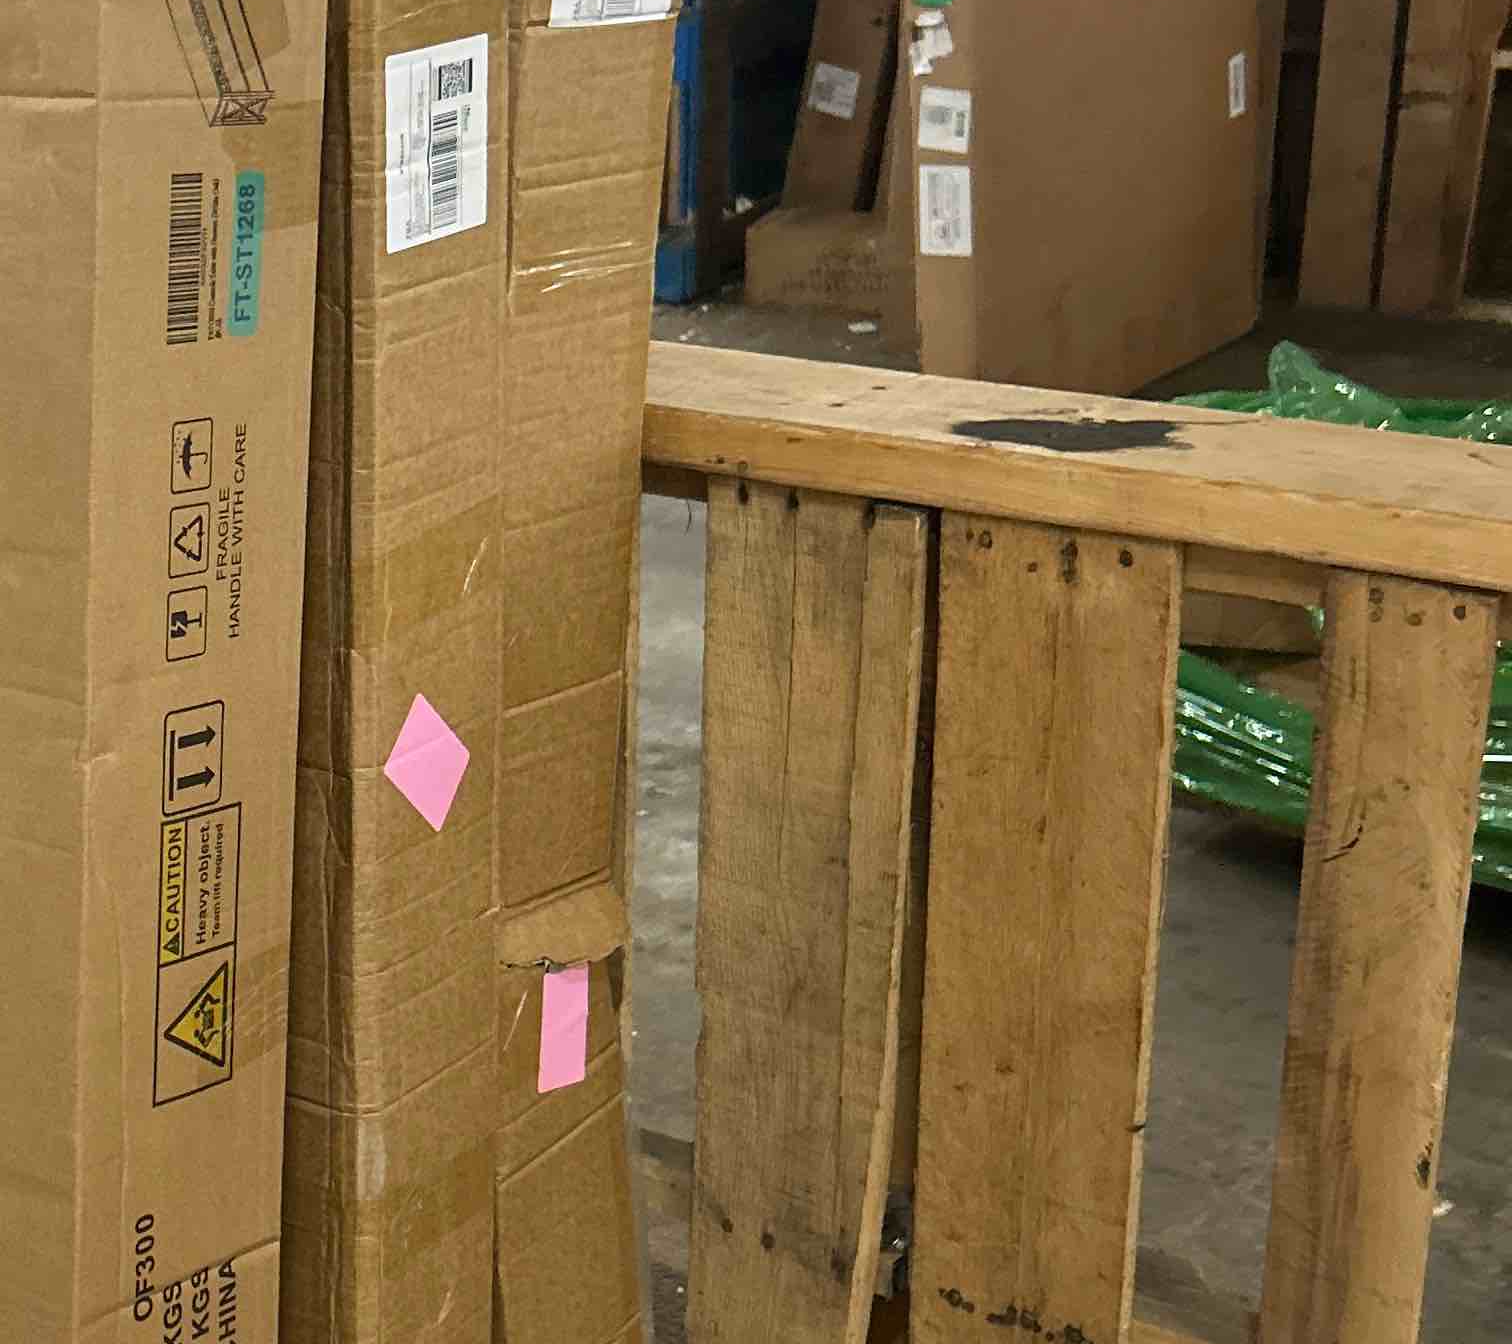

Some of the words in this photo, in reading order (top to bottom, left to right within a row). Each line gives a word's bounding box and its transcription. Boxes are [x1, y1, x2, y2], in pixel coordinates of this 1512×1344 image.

[235, 184, 256, 322] FT-ST1268
[233, 423, 248, 484] CARE
[216, 487, 231, 580] FRAGILE
[231, 490, 245, 546] WITH
[228, 551, 243, 638] HANDLE
[165, 827, 183, 932] CAUTION
[214, 823, 225, 880] required
[196, 889, 210, 944] Heavy
[212, 908, 222, 939] Team
[133, 1213, 156, 1323] OF300
[191, 1266, 211, 1340] KGS
